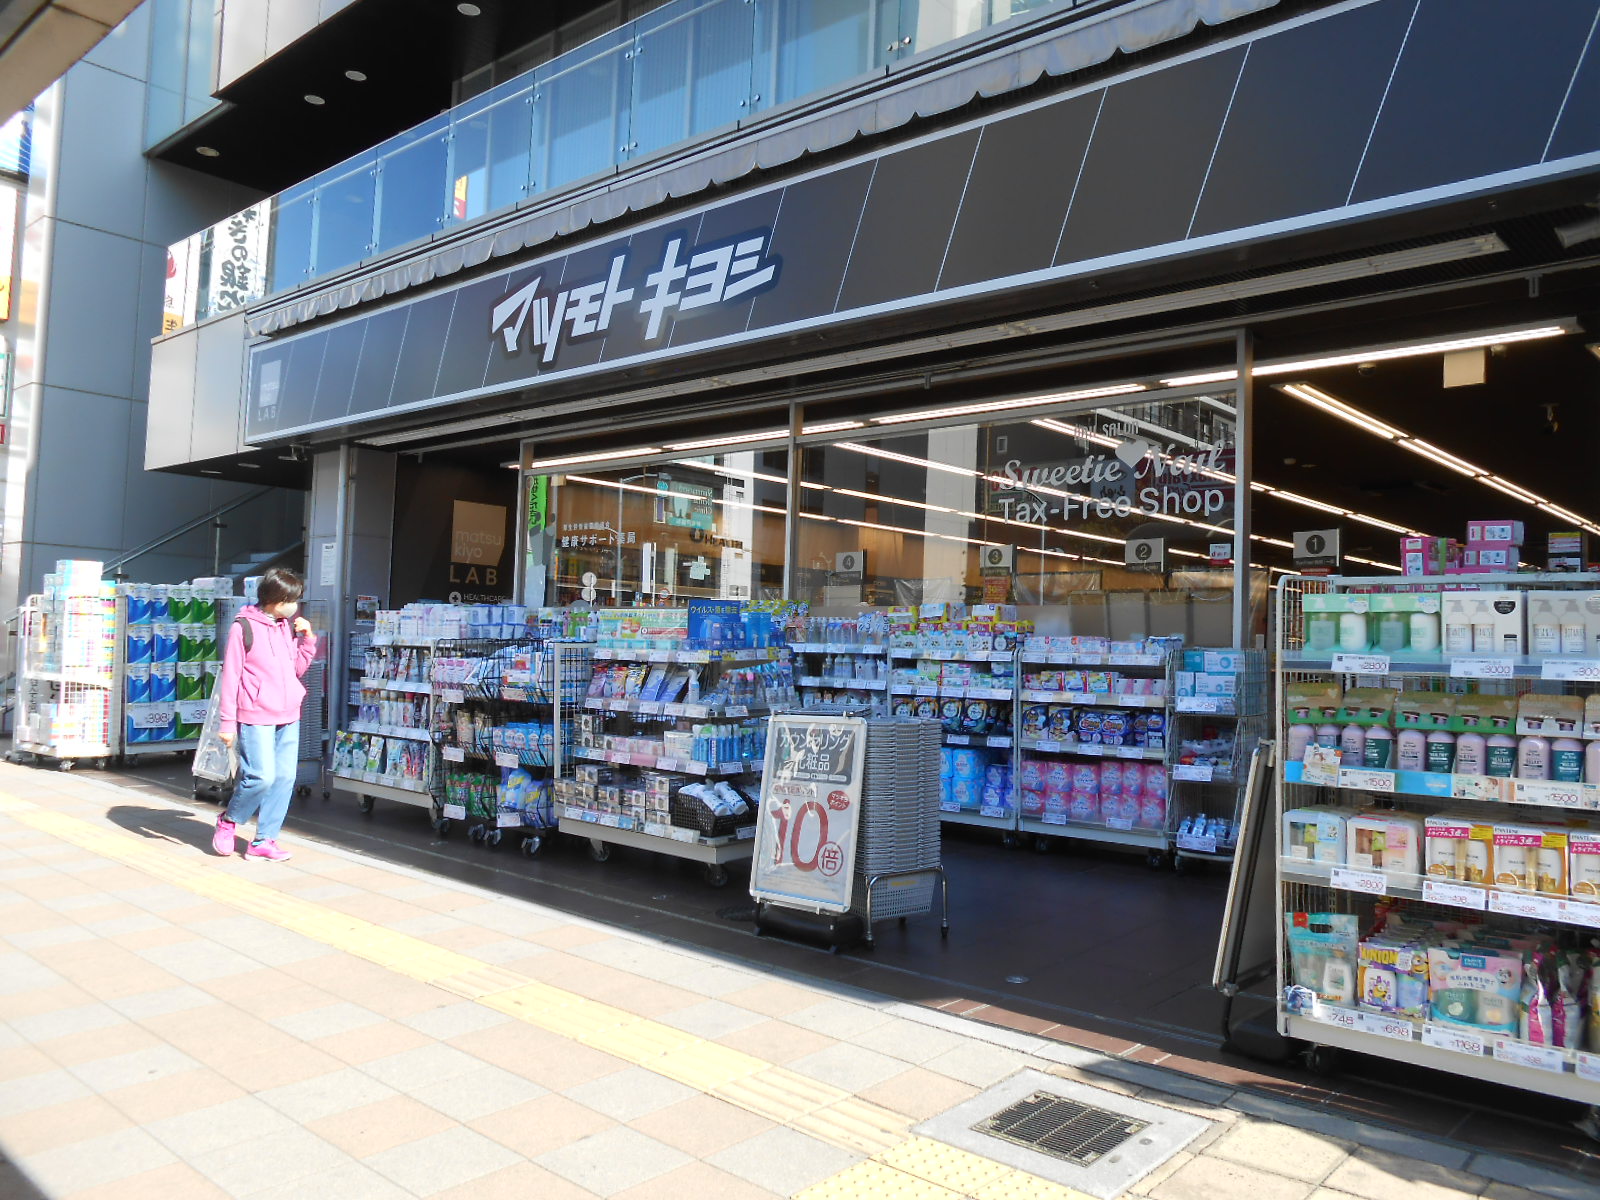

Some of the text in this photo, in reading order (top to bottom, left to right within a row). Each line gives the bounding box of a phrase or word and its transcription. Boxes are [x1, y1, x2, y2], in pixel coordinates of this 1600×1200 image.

[492, 235, 776, 363] マツモトキヨシ
[1000, 439, 1226, 490] Sweetie Nail
[998, 493, 1132, 525] Tax-Free
[1139, 485, 1225, 517] Shop
[455, 530, 502, 546] matsu
[561, 531, 637, 548] 健康サポート薬局
[454, 543, 483, 564] kiyo
[449, 564, 498, 586] LAB
[771, 798, 829, 873] 10
[820, 847, 839, 869] 倍
